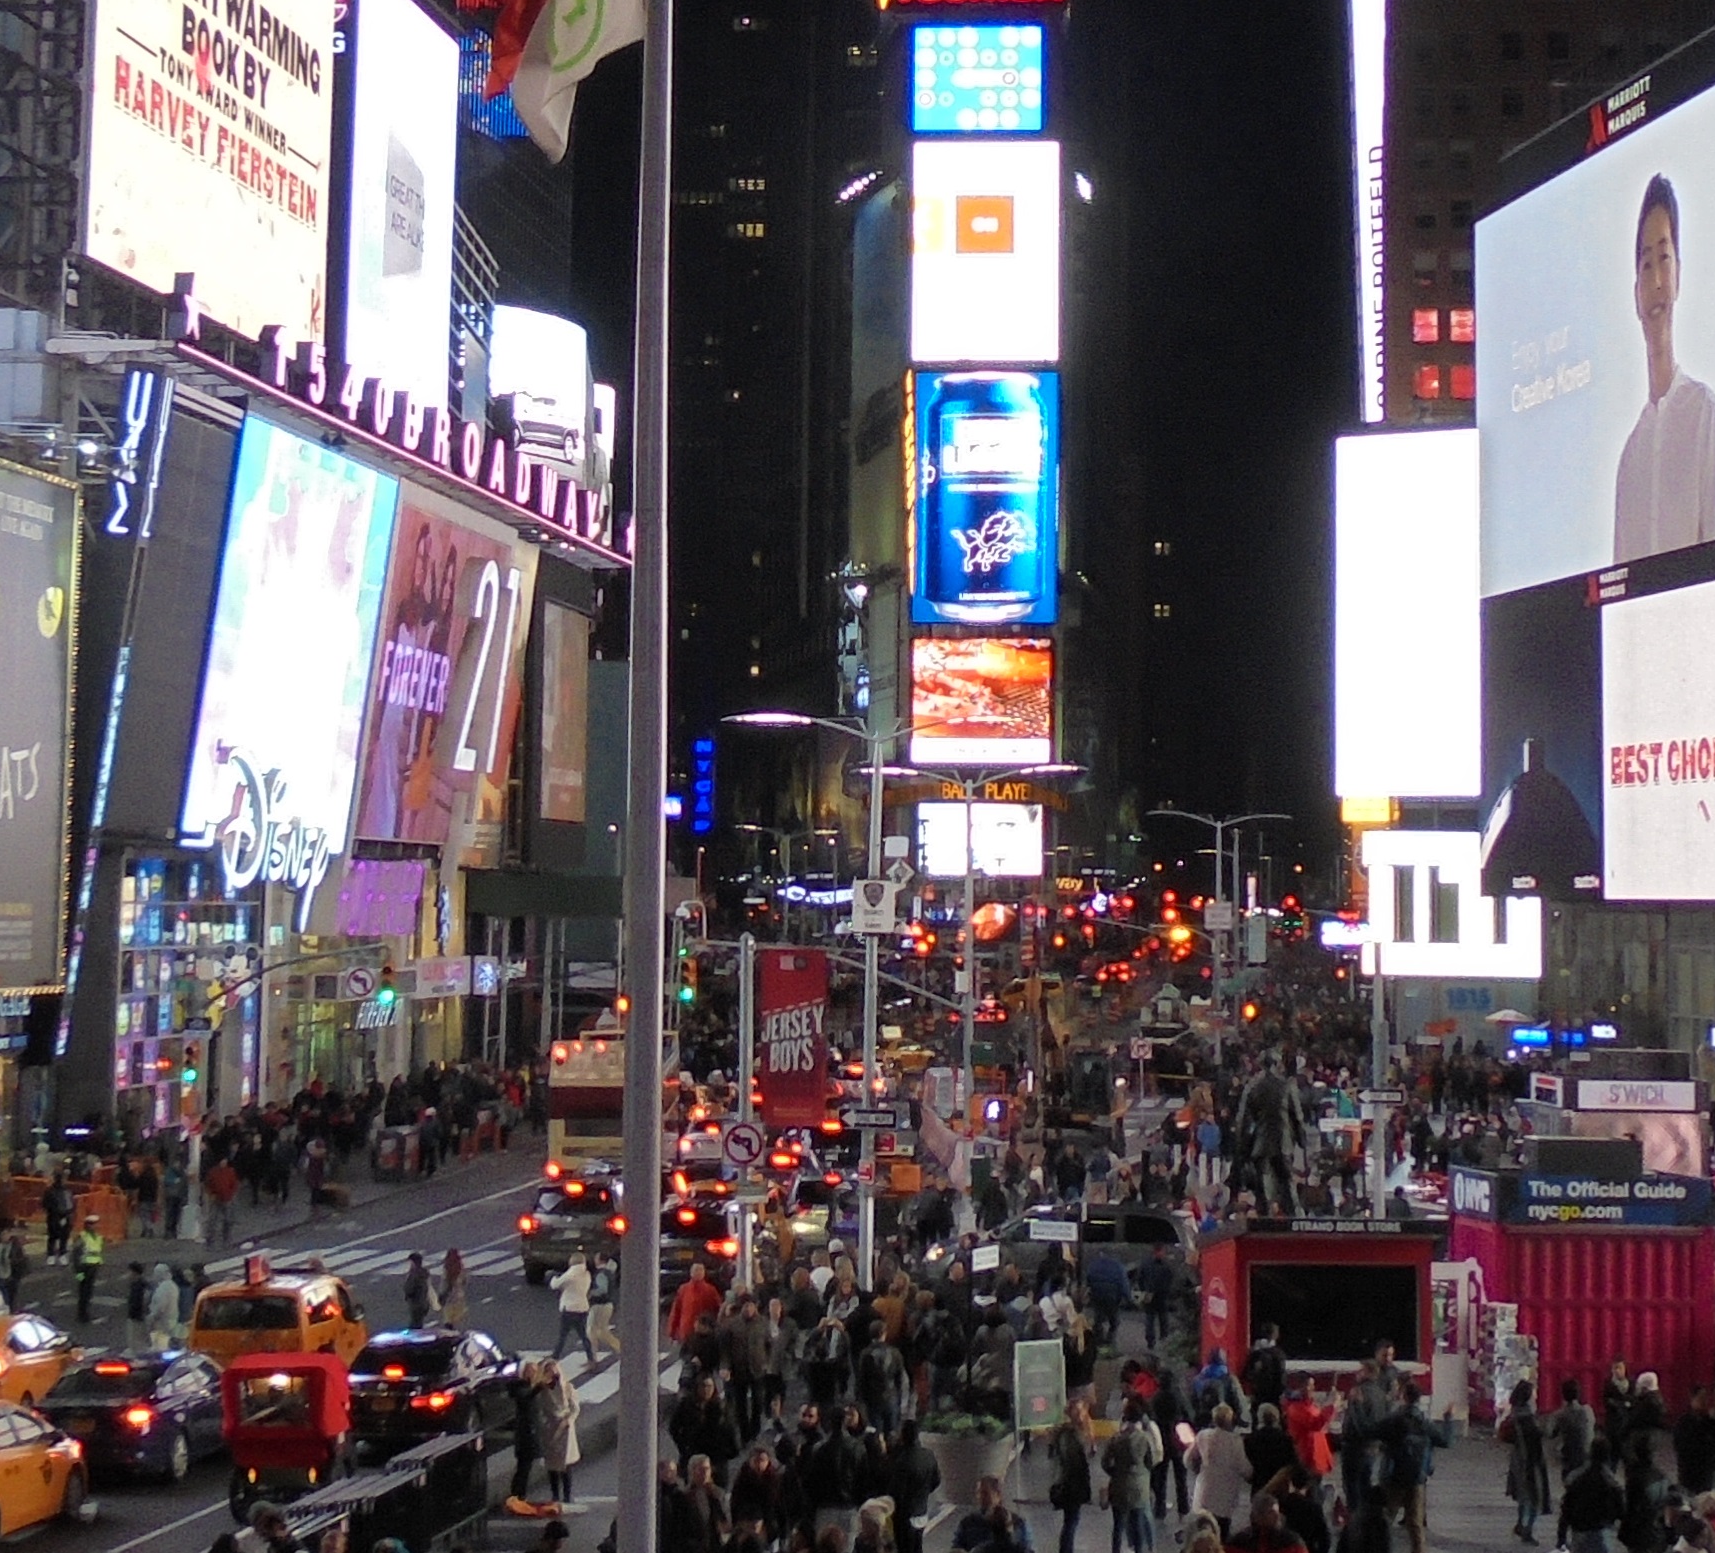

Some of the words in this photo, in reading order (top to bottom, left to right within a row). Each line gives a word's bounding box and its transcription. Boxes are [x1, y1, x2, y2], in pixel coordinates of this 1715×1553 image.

[181, 3, 239, 84] BOOK
[243, 50, 271, 110] BY
[159, 46, 196, 89] TONY
[244, 98, 287, 156] WINNER
[1607, 76, 1651, 115] MARRIOTT
[113, 54, 211, 157] HARVEY
[215, 127, 318, 227] FIERSTEIN
[1607, 101, 1646, 136] MARQUIS
[273, 324, 393, 438] 1540
[404, 392, 603, 538] BROADWAY
[382, 640, 450, 715] FOREVER
[454, 559, 520, 773] 21
[1611, 742, 1664, 787] BEST
[761, 1002, 826, 1044] JERSEY
[769, 1038, 815, 1073] BOYS
[1528, 1181, 1563, 1198] The
[1567, 1180, 1630, 1198] Official
[1634, 1180, 1687, 1198] Guide
[1528, 1203, 1623, 1221] nycgo.com
